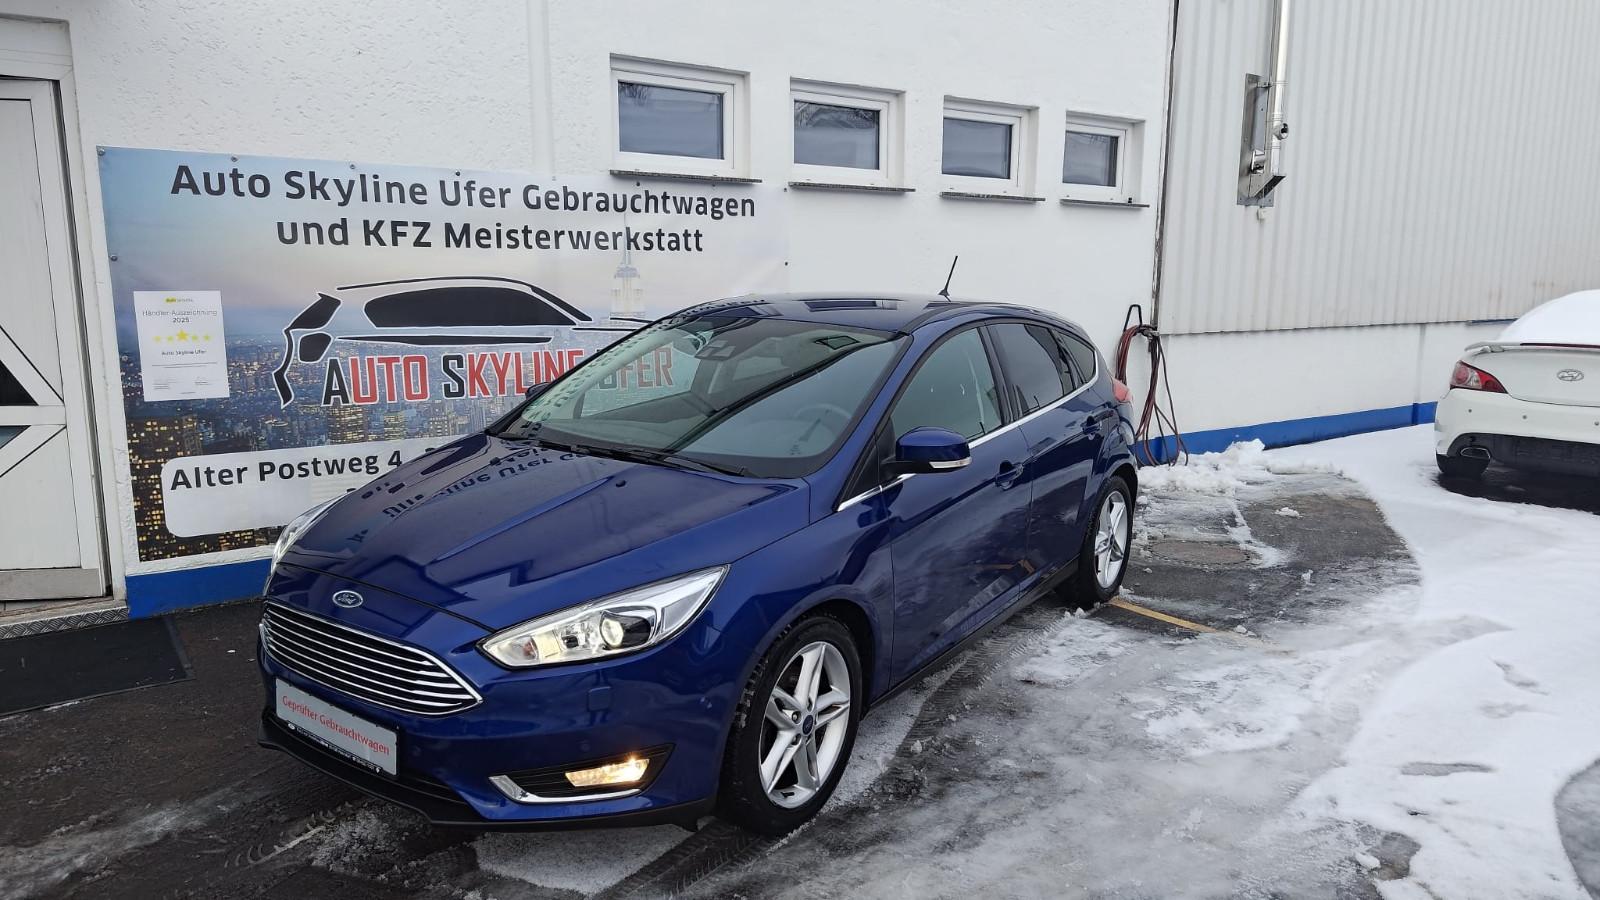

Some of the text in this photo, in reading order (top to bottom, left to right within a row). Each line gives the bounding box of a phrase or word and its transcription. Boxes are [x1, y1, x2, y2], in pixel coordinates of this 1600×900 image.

[170, 164, 755, 220] Auto Skyline Ufer Gebrauchtwagen
[276, 217, 704, 252] und KFZ Meisterwerkstatt
[322, 355, 429, 406] AUTO
[170, 465, 248, 491] Alter
[258, 454, 380, 482] Postweg
[282, 695, 318, 721] Geprüfter
[319, 714, 390, 756] Gebrauchtwagen
